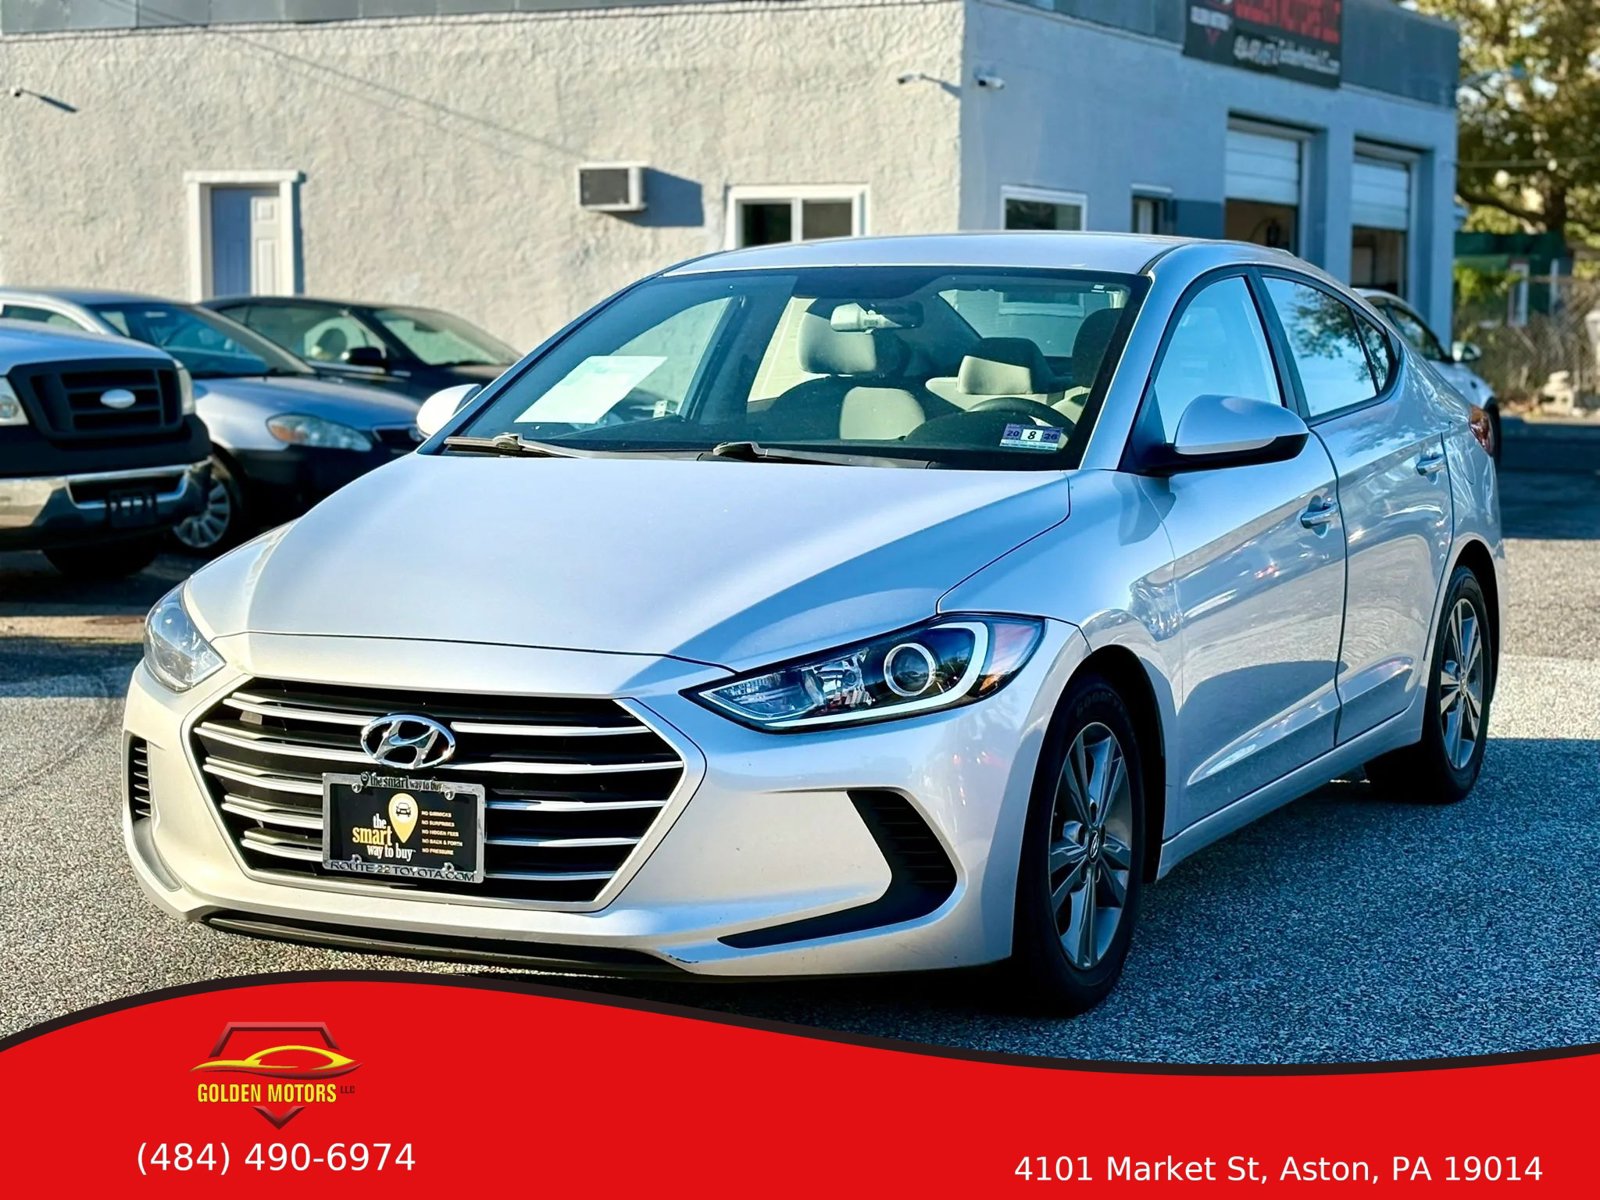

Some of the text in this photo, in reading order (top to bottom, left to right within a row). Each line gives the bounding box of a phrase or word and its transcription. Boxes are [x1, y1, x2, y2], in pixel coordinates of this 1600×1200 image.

[1027, 430, 1037, 440] 8
[370, 773, 383, 787] the
[383, 775, 409, 789] smart
[410, 780, 422, 792] way
[422, 779, 430, 790] to
[373, 813, 387, 829] the
[352, 826, 393, 846] smart
[367, 842, 413, 862] way to buy
[330, 861, 475, 882] ROUTE 22 TOYOTA.COM
